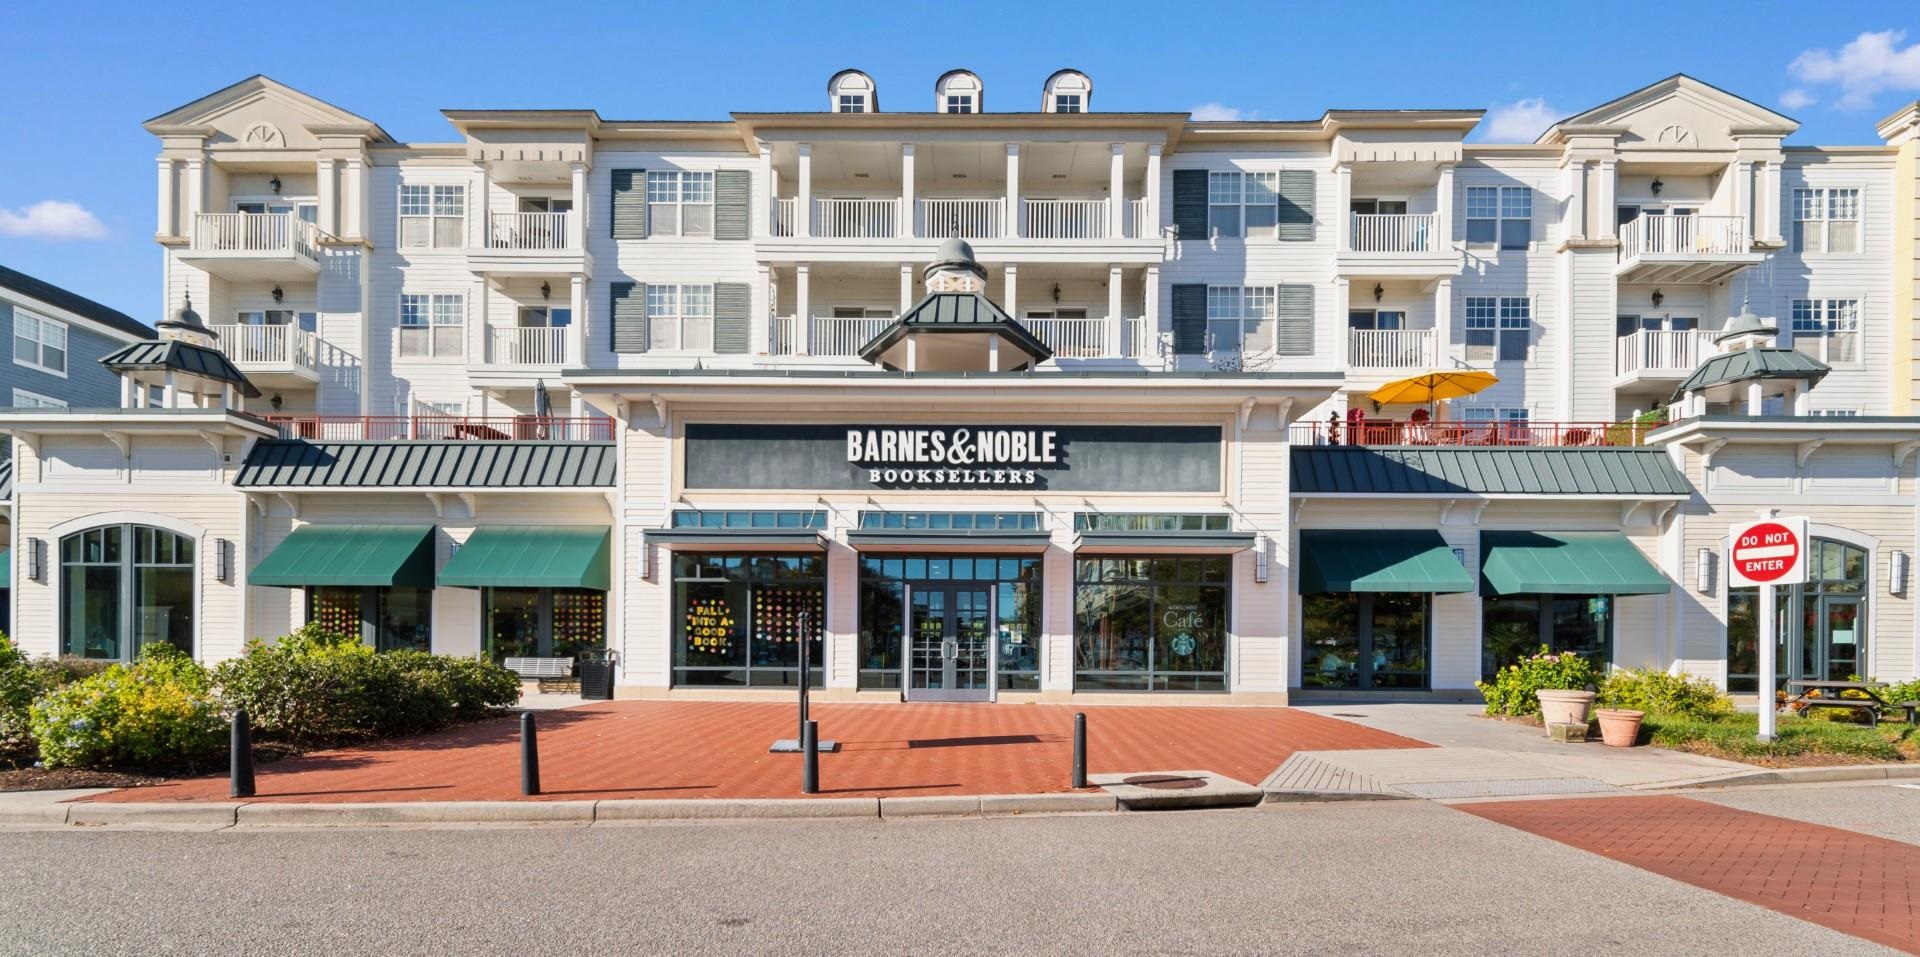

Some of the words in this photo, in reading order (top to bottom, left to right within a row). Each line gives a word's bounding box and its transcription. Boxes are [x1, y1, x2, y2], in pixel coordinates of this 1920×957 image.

[869, 469, 1036, 484] BOOKSELLERS
[1741, 535, 1758, 547] DO
[1765, 532, 1789, 545] NOT
[1745, 560, 1784, 572] ENTER
[696, 606, 724, 616] FALL
[692, 616, 717, 626] INTO
[720, 616, 729, 626] A
[1163, 610, 1204, 628] Café
[695, 627, 726, 637] GOOD
[694, 636, 727, 647] BOOK
